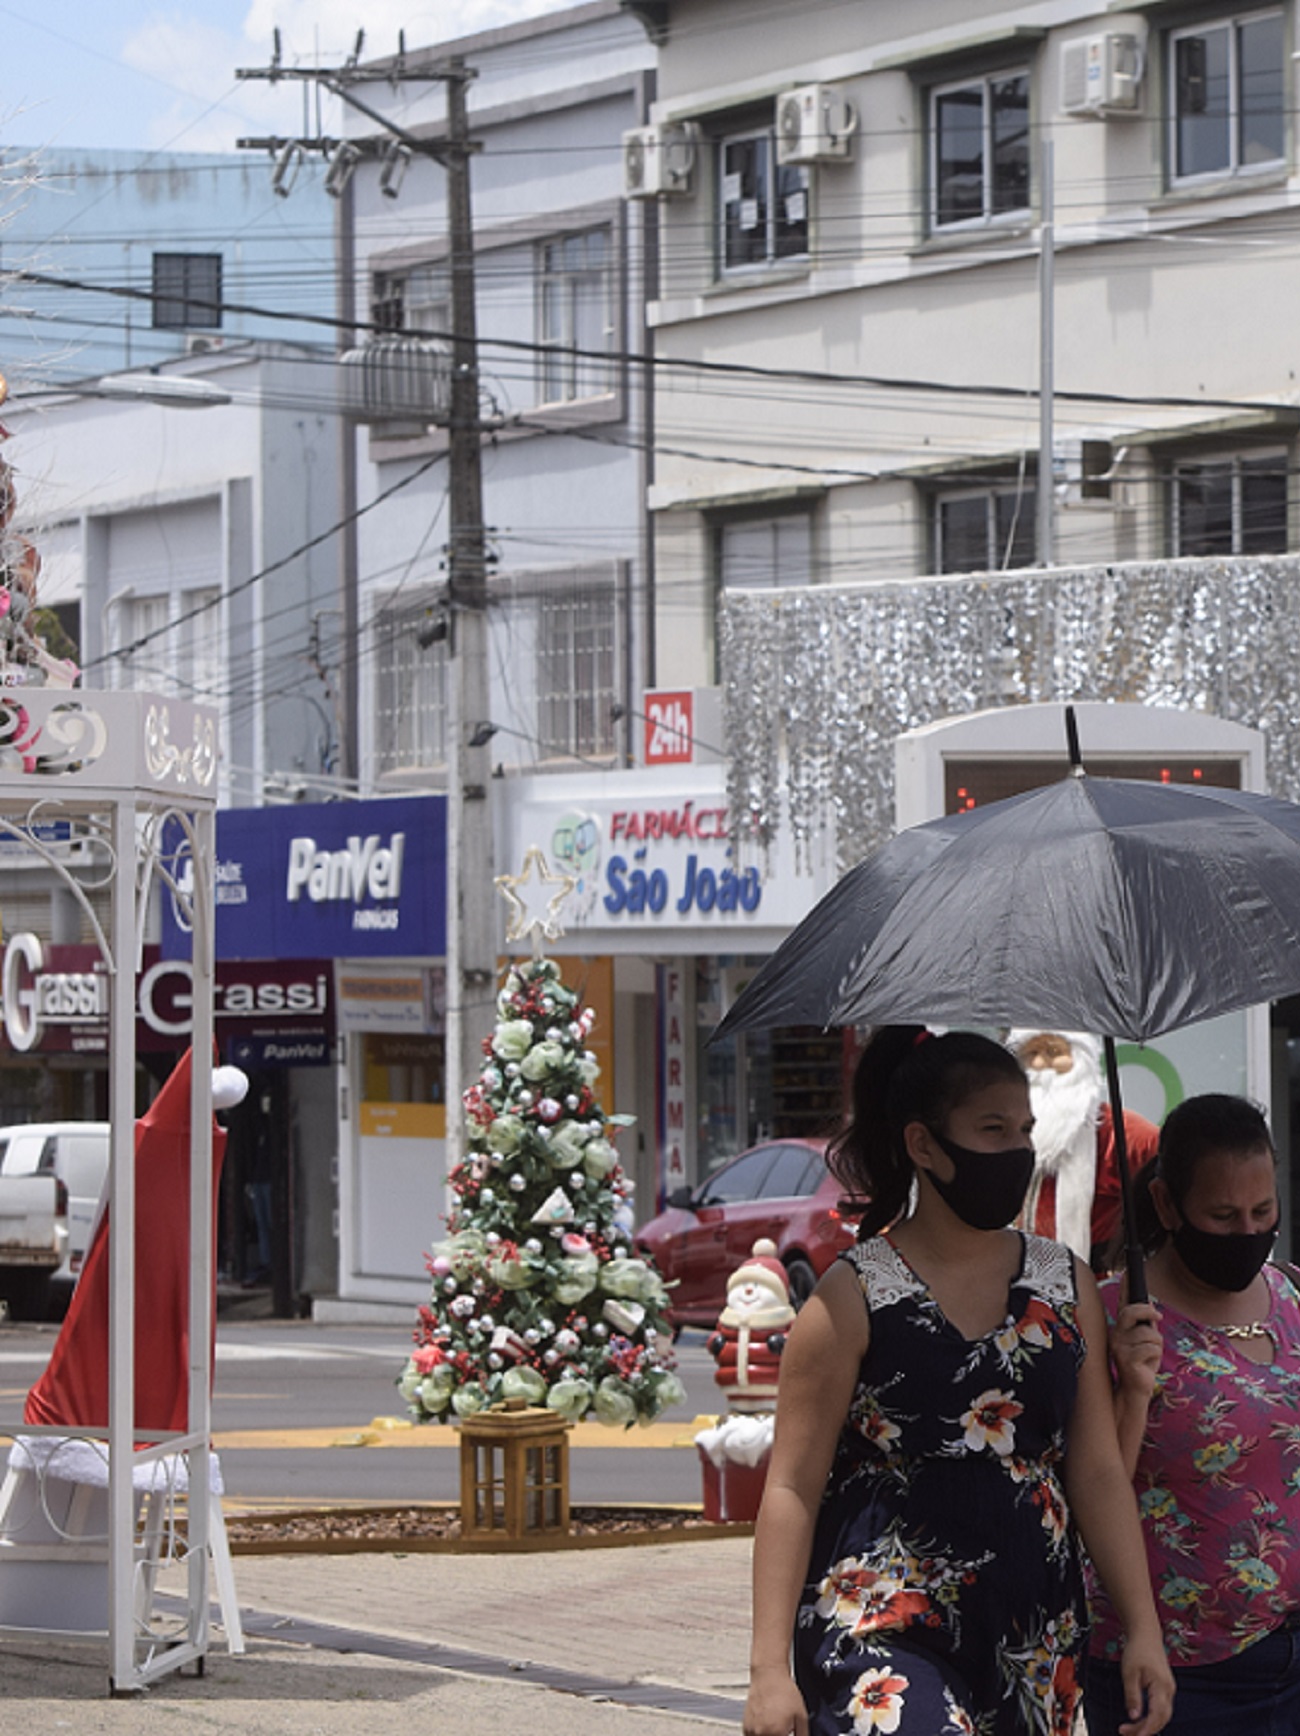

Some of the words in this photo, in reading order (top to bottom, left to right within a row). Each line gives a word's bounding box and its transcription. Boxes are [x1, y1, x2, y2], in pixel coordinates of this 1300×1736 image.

[649, 700, 689, 756] 24h
[609, 800, 762, 841] FARMÁCI
[286, 832, 405, 903] PanVel
[603, 848, 667, 914] São
[676, 847, 762, 914] João
[138, 960, 328, 1036] Gassi
